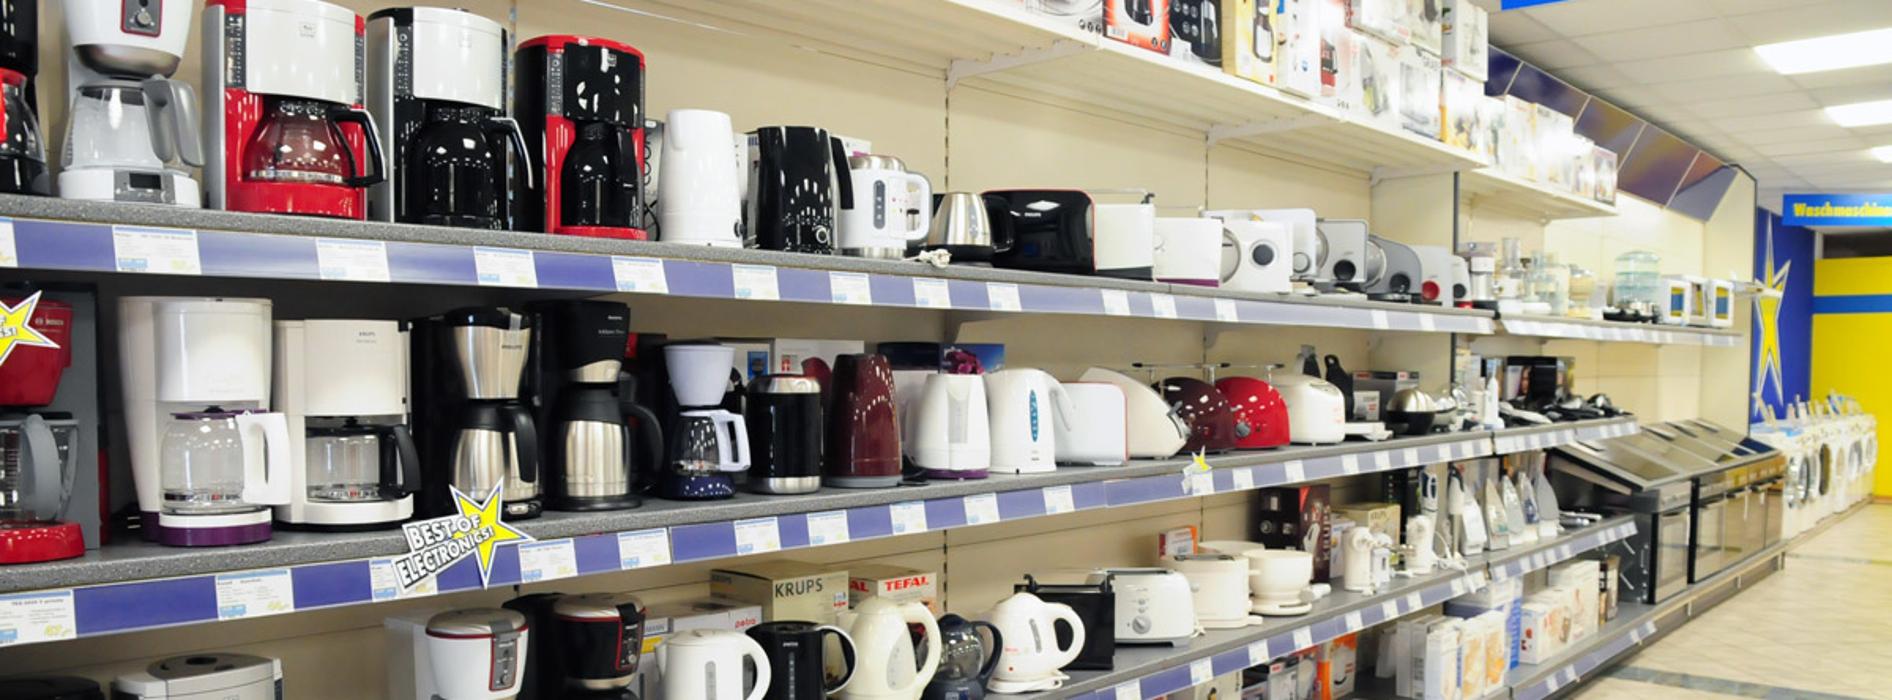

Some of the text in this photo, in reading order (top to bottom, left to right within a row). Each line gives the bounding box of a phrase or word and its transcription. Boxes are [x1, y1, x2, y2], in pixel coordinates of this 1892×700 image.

[408, 515, 480, 550] BEST OF
[396, 527, 494, 588] ELECTRONICS!
[775, 578, 823, 598] KRUPS
[885, 576, 929, 592] TEFAL
